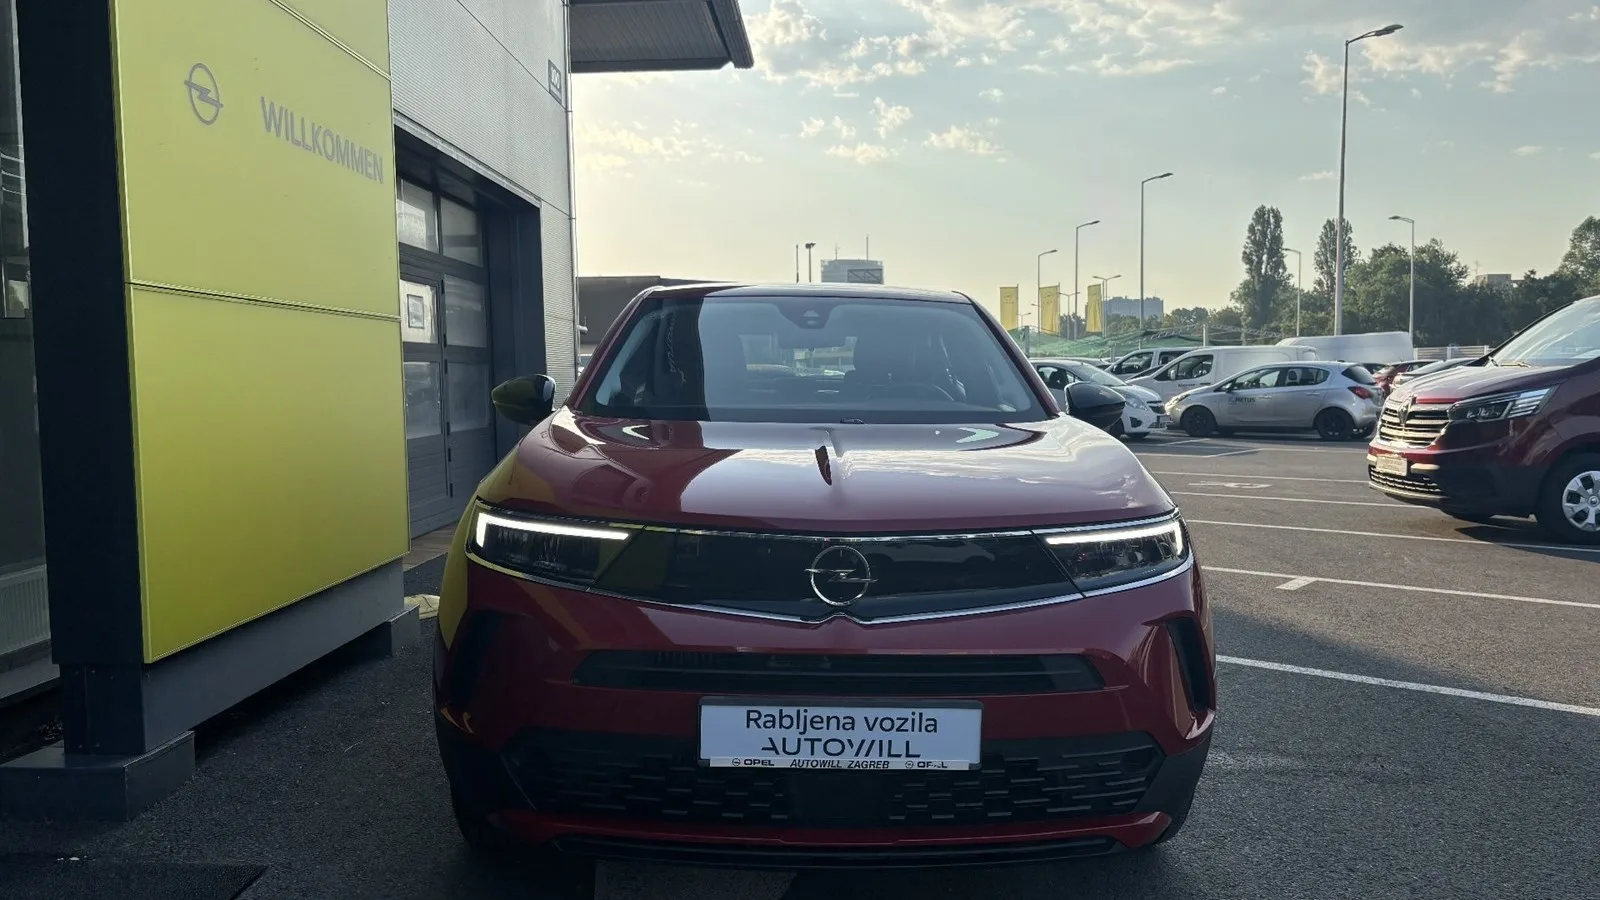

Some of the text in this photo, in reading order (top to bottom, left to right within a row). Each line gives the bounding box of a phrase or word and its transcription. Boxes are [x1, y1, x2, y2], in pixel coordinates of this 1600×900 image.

[260, 96, 384, 184] WILLKOMMEN
[746, 709, 938, 735] Rabljena vozila
[761, 737, 921, 758] AUTOWILL
[743, 758, 775, 767] OPEL
[790, 758, 890, 769] AUTOWILL ZAGREB
[917, 760, 948, 769] OPL
